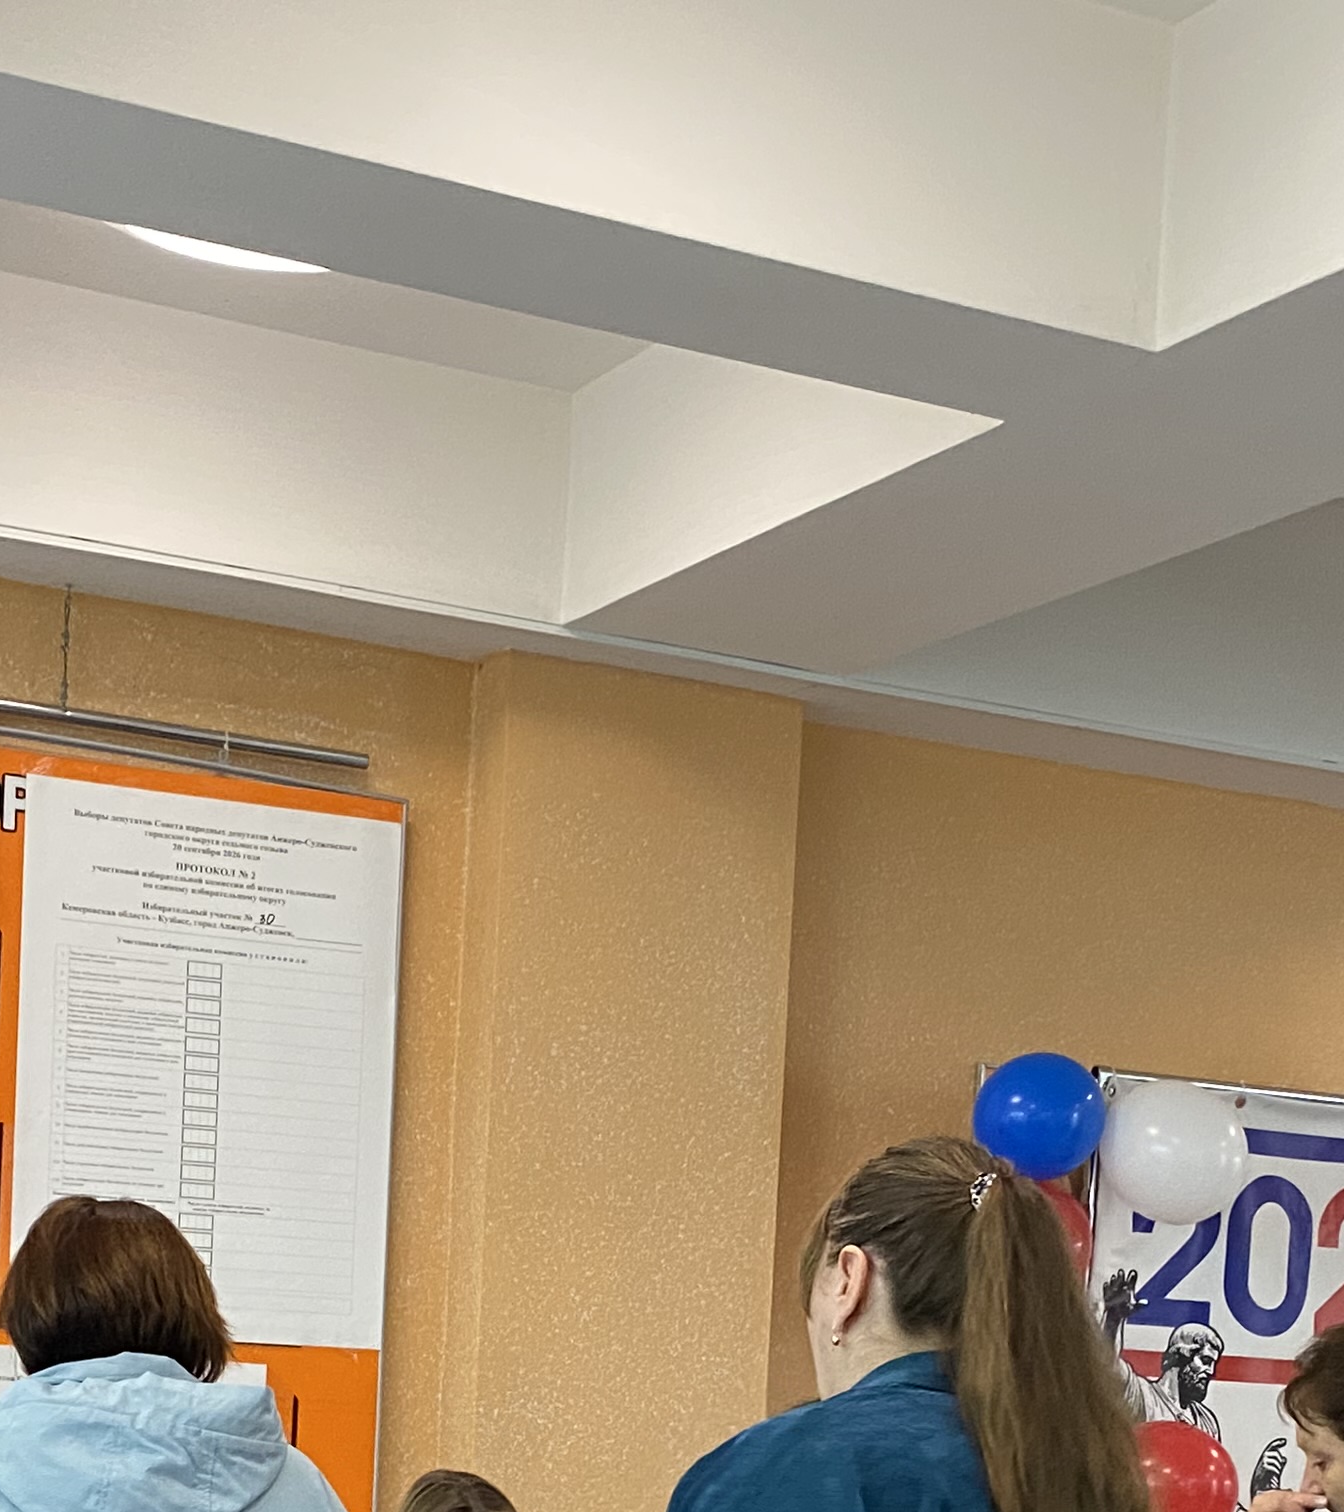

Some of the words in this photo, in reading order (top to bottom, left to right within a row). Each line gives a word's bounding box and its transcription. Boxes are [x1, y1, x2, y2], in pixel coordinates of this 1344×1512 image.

[175, 861, 236, 877] ПРОТОКОЛ
[238, 868, 249, 879] №
[250, 871, 257, 880] 2
